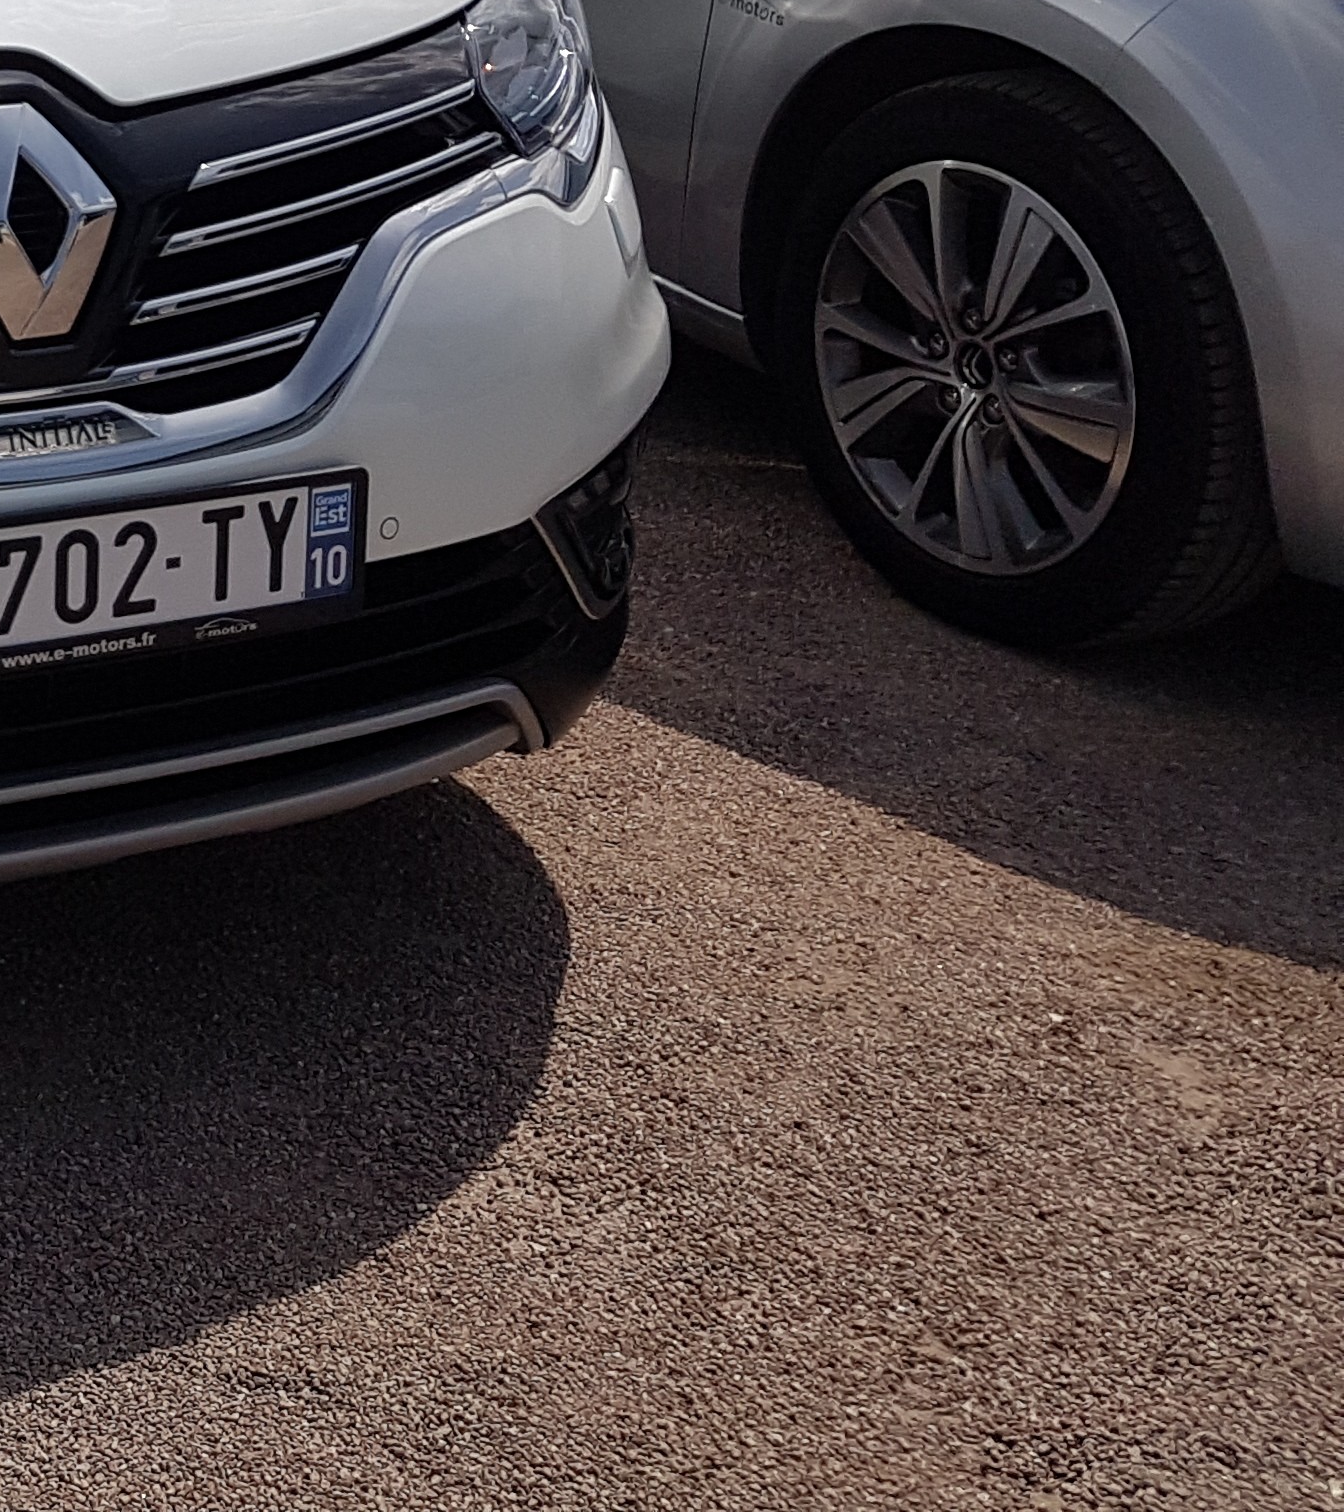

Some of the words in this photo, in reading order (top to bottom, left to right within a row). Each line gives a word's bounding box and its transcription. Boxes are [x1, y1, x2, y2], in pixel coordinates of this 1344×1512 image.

[315, 491, 349, 507] Grand
[314, 503, 348, 527] Est
[310, 544, 348, 589] 10
[0, 631, 157, 669] www.e-motors.fr
